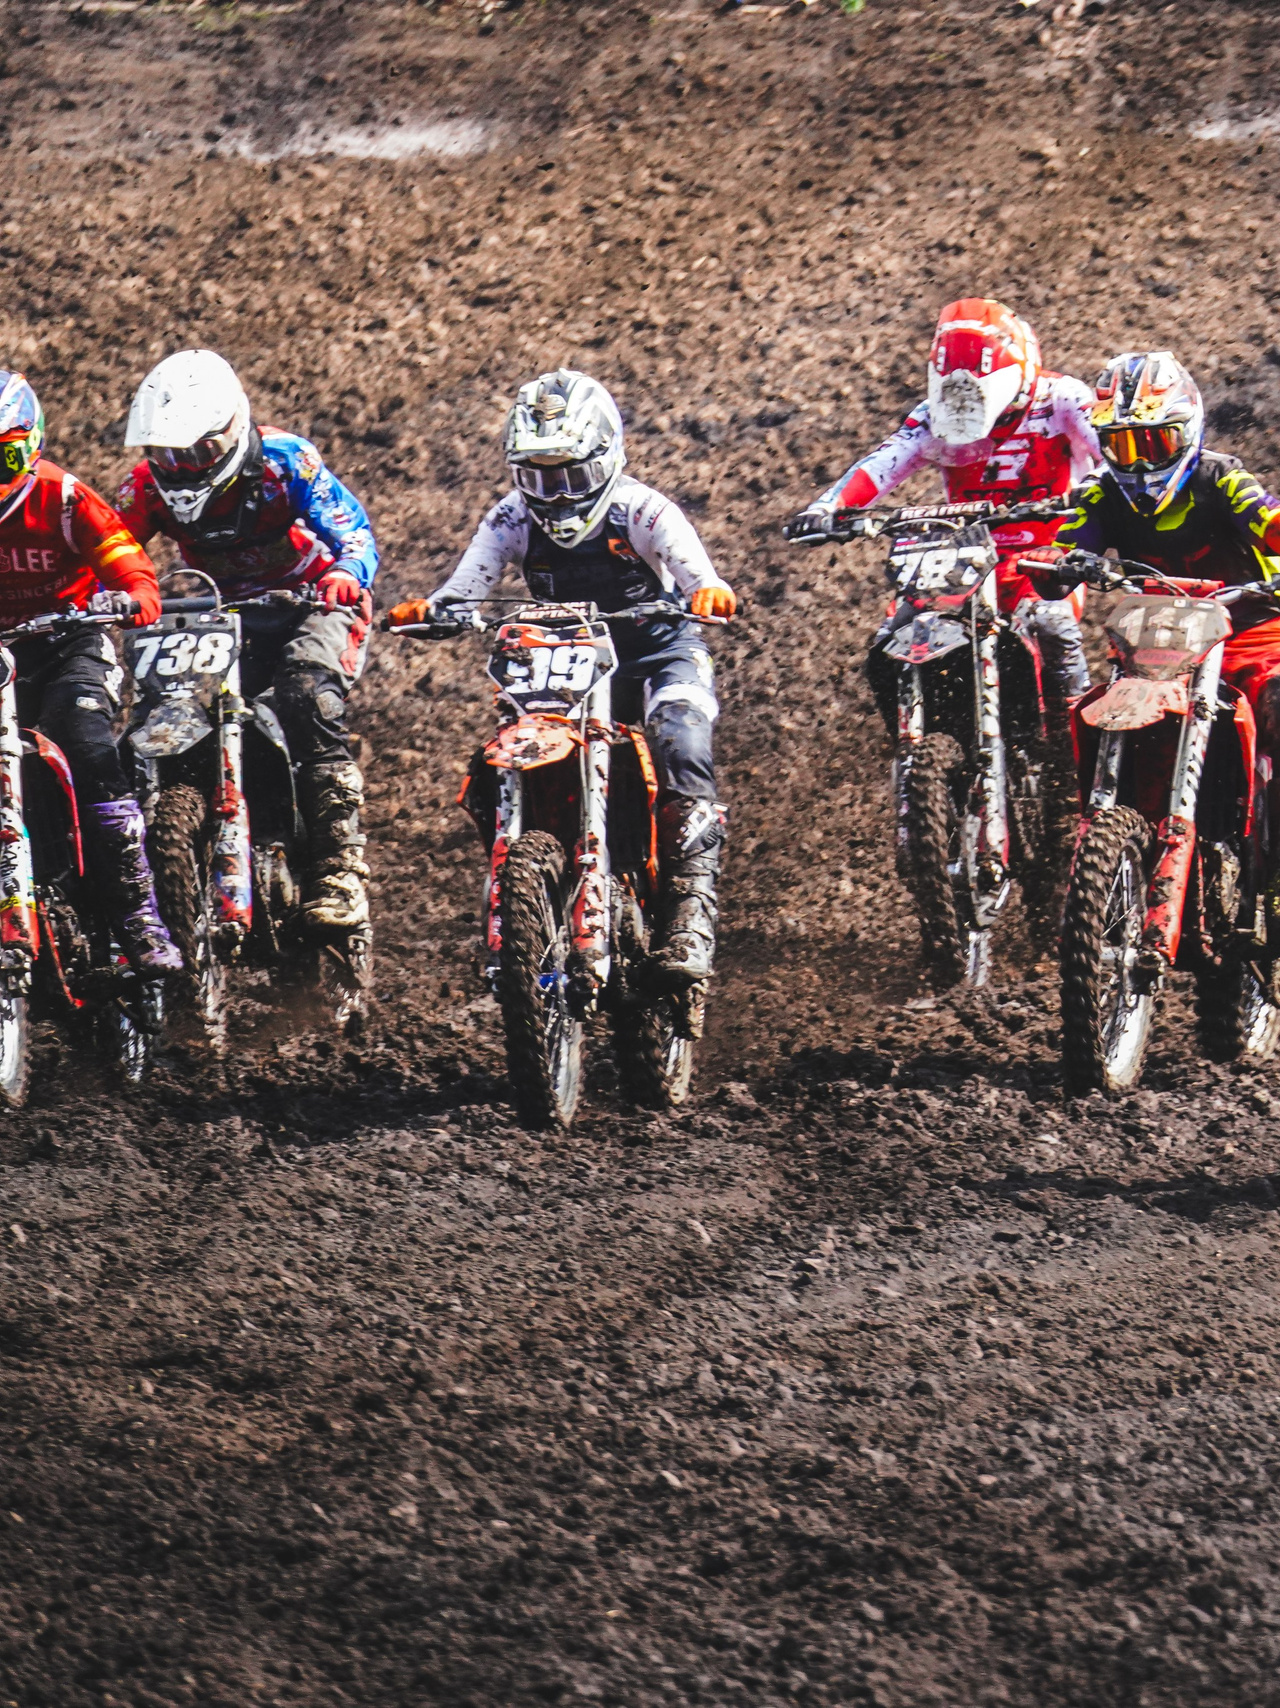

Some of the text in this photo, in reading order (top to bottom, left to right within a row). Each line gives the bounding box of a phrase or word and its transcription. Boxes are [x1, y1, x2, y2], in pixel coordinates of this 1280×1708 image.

[1118, 606, 1208, 655] 111
[133, 632, 235, 680] 738
[505, 645, 598, 694] 99
